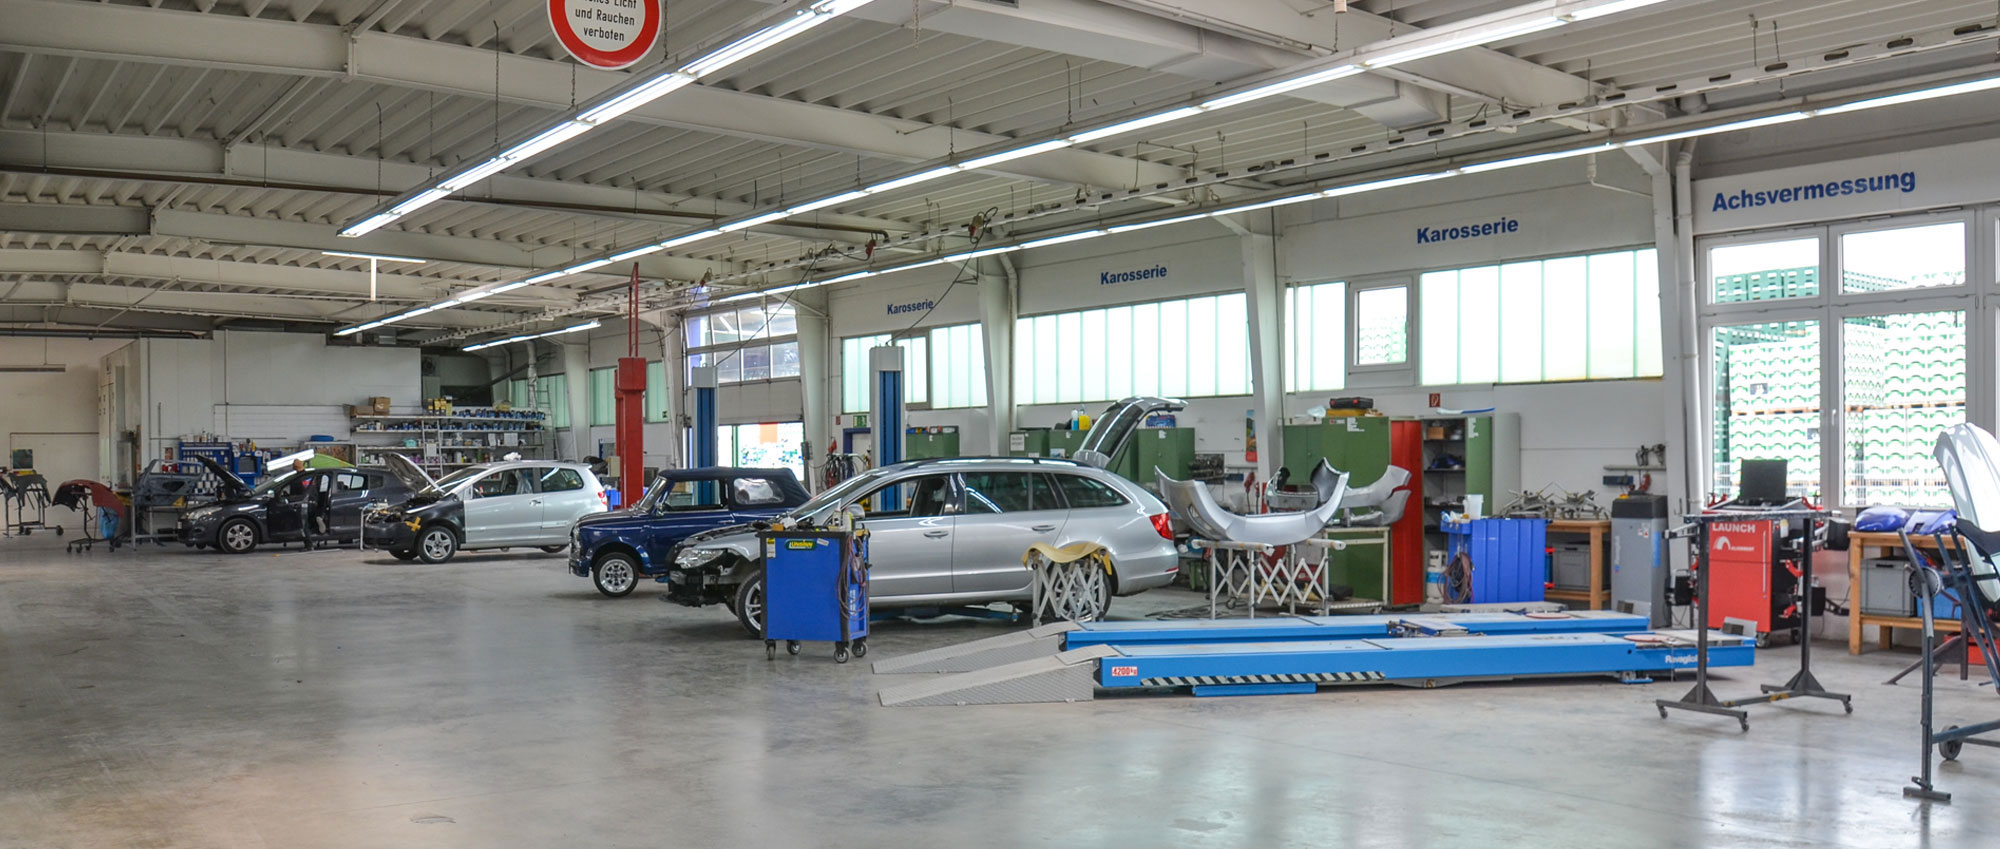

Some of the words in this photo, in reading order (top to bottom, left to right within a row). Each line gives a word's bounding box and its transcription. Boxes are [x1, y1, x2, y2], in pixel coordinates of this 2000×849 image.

[575, 8, 592, 19] und
[596, 9, 635, 26] Rauchen
[583, 27, 625, 41] verboten
[1712, 171, 1915, 212] Achsvermessung
[1417, 217, 1518, 244] Karosserie
[1100, 264, 1167, 285] Karosserie
[887, 298, 934, 315] Karosserie
[1712, 522, 1756, 533] LAUNCH
